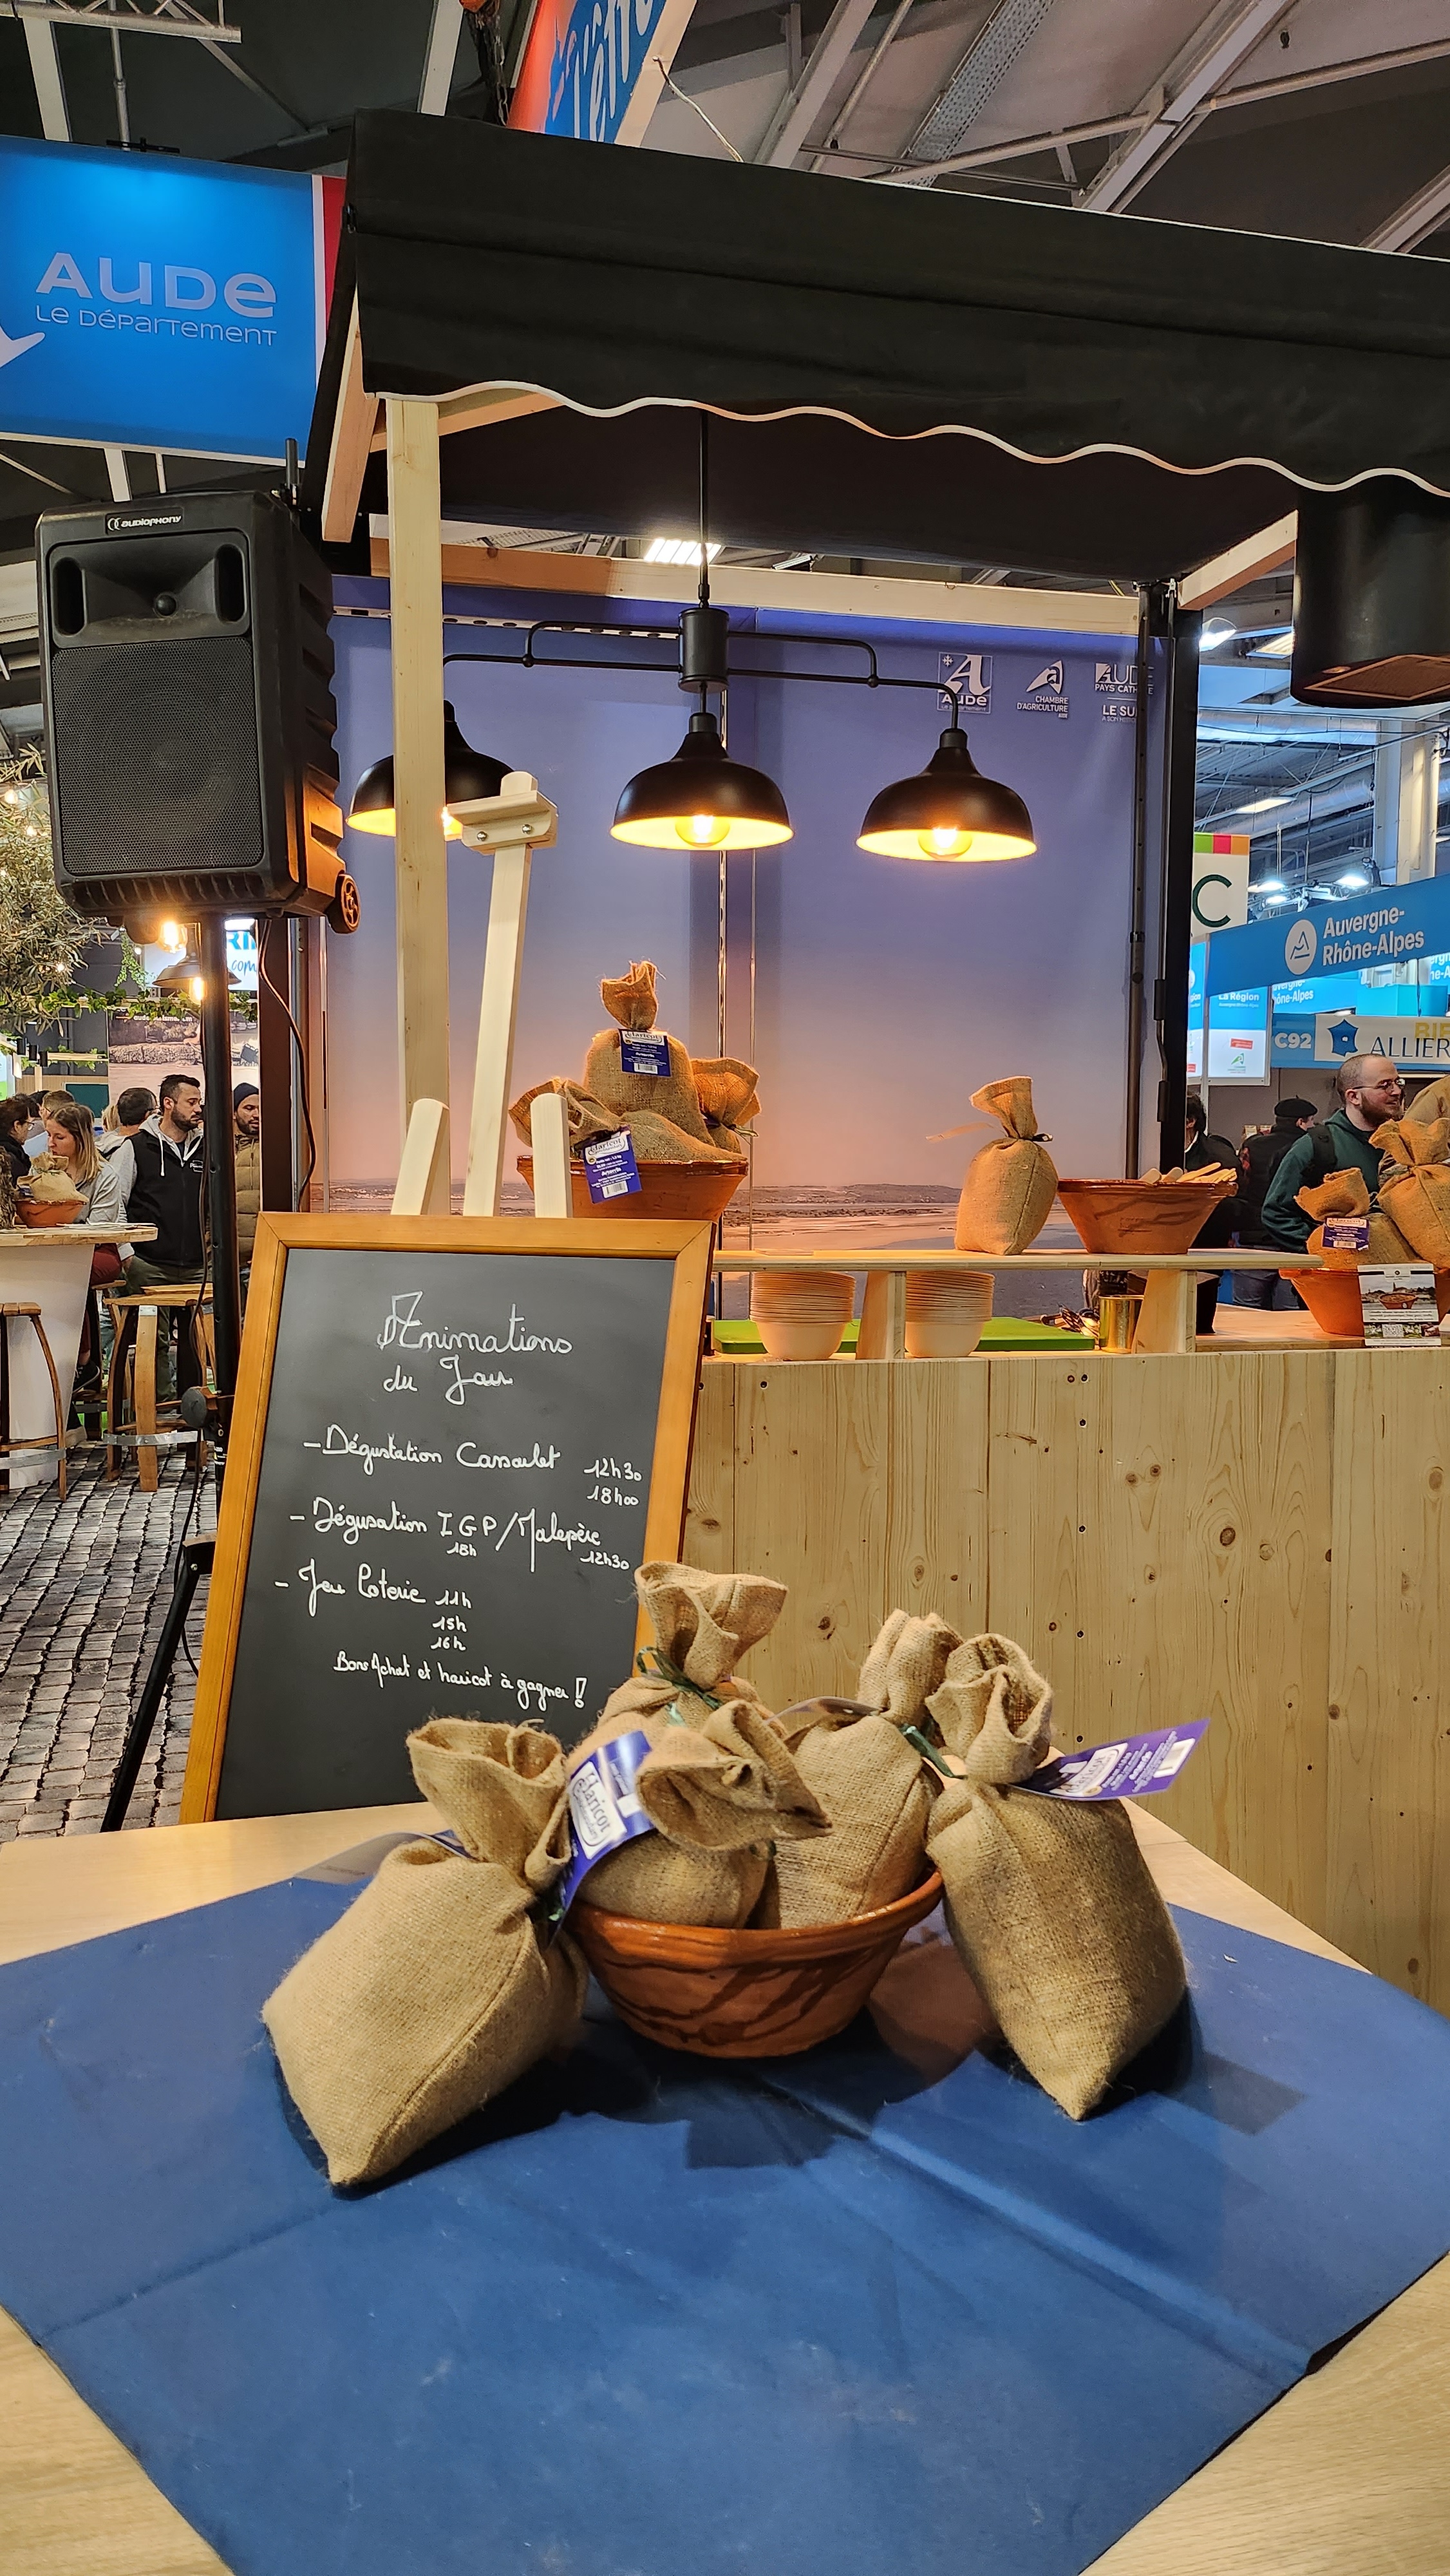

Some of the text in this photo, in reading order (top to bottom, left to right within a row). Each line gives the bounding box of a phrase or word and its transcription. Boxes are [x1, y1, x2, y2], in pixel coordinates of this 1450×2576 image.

[1095, 684, 1115, 692] PAYS
[1017, 702, 1068, 713] D'AGRICULTURE
[1035, 696, 1069, 705] CHAMBRE
[1102, 704, 1137, 717] LE SU
[1323, 906, 1405, 938] Auvergne-
[1322, 930, 1425, 966] Rhône-Alpes
[1230, 992, 1259, 1003] Région
[1274, 1032, 1312, 1049] C92
[1371, 1036, 1450, 1058] ALLIER
[383, 1365, 418, 1392] du
[456, 1441, 561, 1469] Cassoulet
[583, 1457, 642, 1481] 12h30
[587, 1485, 639, 1506] 18h00
[446, 1542, 477, 1557] 18h
[580, 1550, 630, 1571] 12h30
[298, 1557, 346, 1618] Jeu
[357, 1563, 427, 1604] Loterie
[434, 1589, 472, 1609] 11h
[432, 1615, 467, 1633] 15h
[429, 1636, 466, 1652] 16h
[417, 1660, 431, 1681] et
[437, 1662, 493, 1687] haricot
[500, 1672, 514, 1690] à
[516, 1679, 570, 1712] gagner
